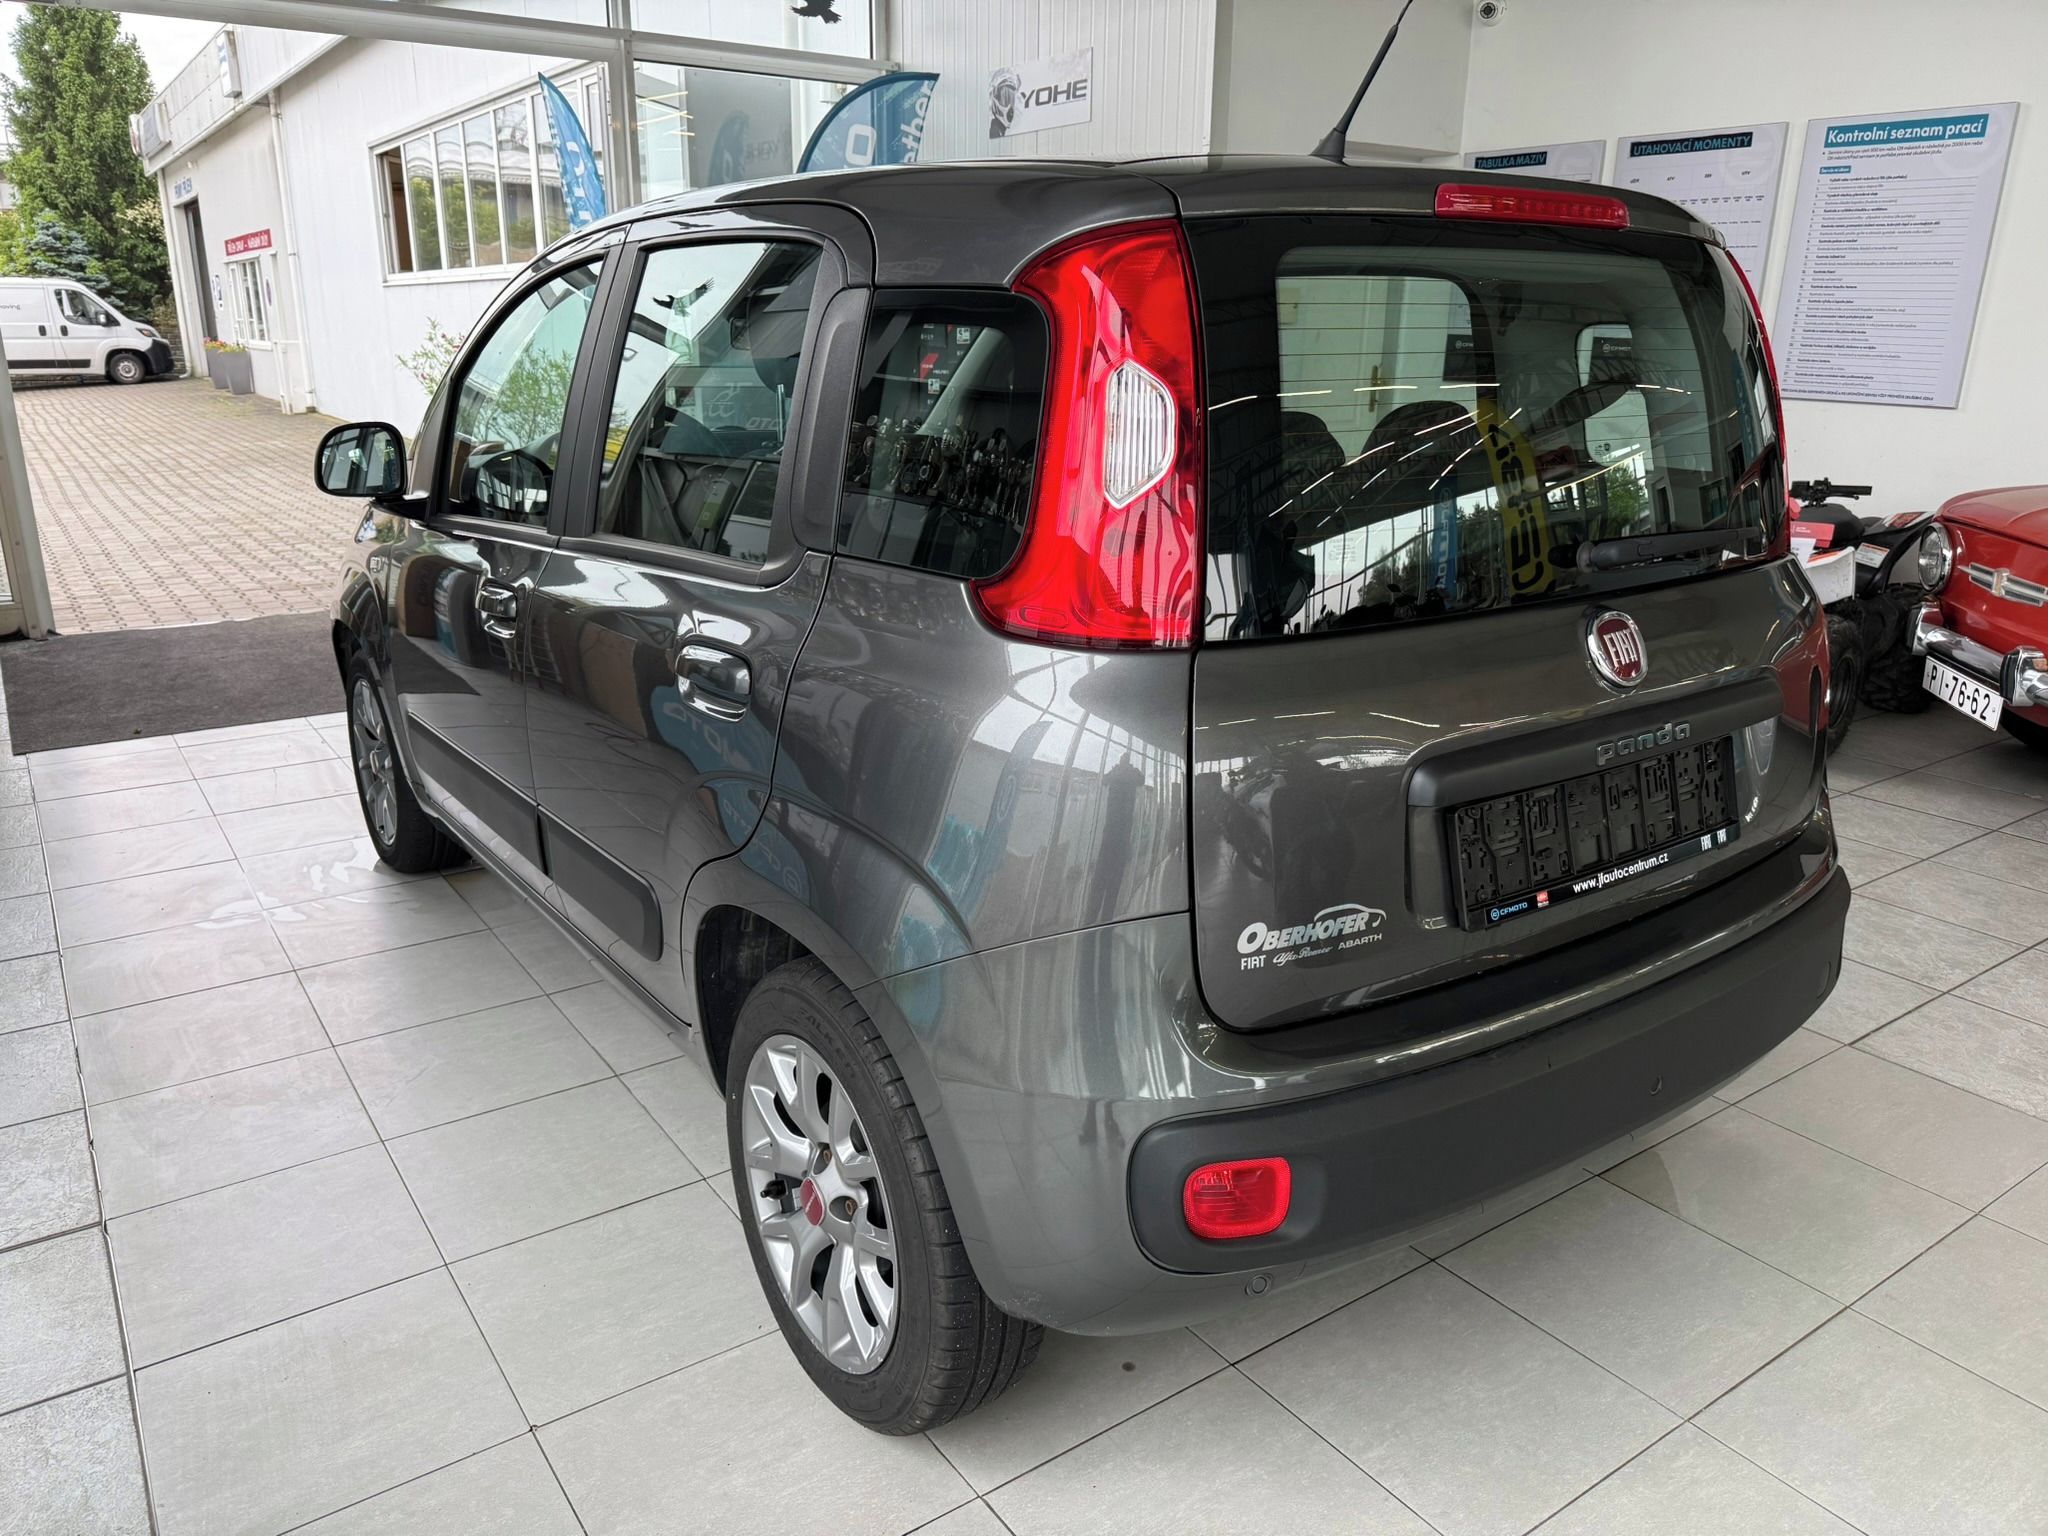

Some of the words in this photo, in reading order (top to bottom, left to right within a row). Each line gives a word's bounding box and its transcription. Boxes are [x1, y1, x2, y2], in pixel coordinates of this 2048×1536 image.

[1020, 79, 1088, 109] YOHE
[1633, 139, 1693, 156] UTAHOVACÍ
[1692, 135, 1751, 150] MOMENTY
[1827, 126, 1889, 144] Kontrolní
[1889, 126, 1943, 140] seznam
[1944, 119, 1983, 139] prací
[1477, 156, 1515, 169] TABULKA
[1515, 153, 1546, 166] MAZIV
[1603, 628, 1638, 667] FIAT
[1928, 664, 1991, 722] PI-76-62
[1597, 723, 1691, 766] panda
[1572, 852, 1669, 893] www.jfautocentrum.cz
[1500, 901, 1528, 916] CFMOTO
[1237, 911, 1370, 954] OBERHOFER
[1241, 954, 1267, 970] FIAT
[1272, 952, 1299, 967] Alfa
[1338, 933, 1383, 950] ABARTH
